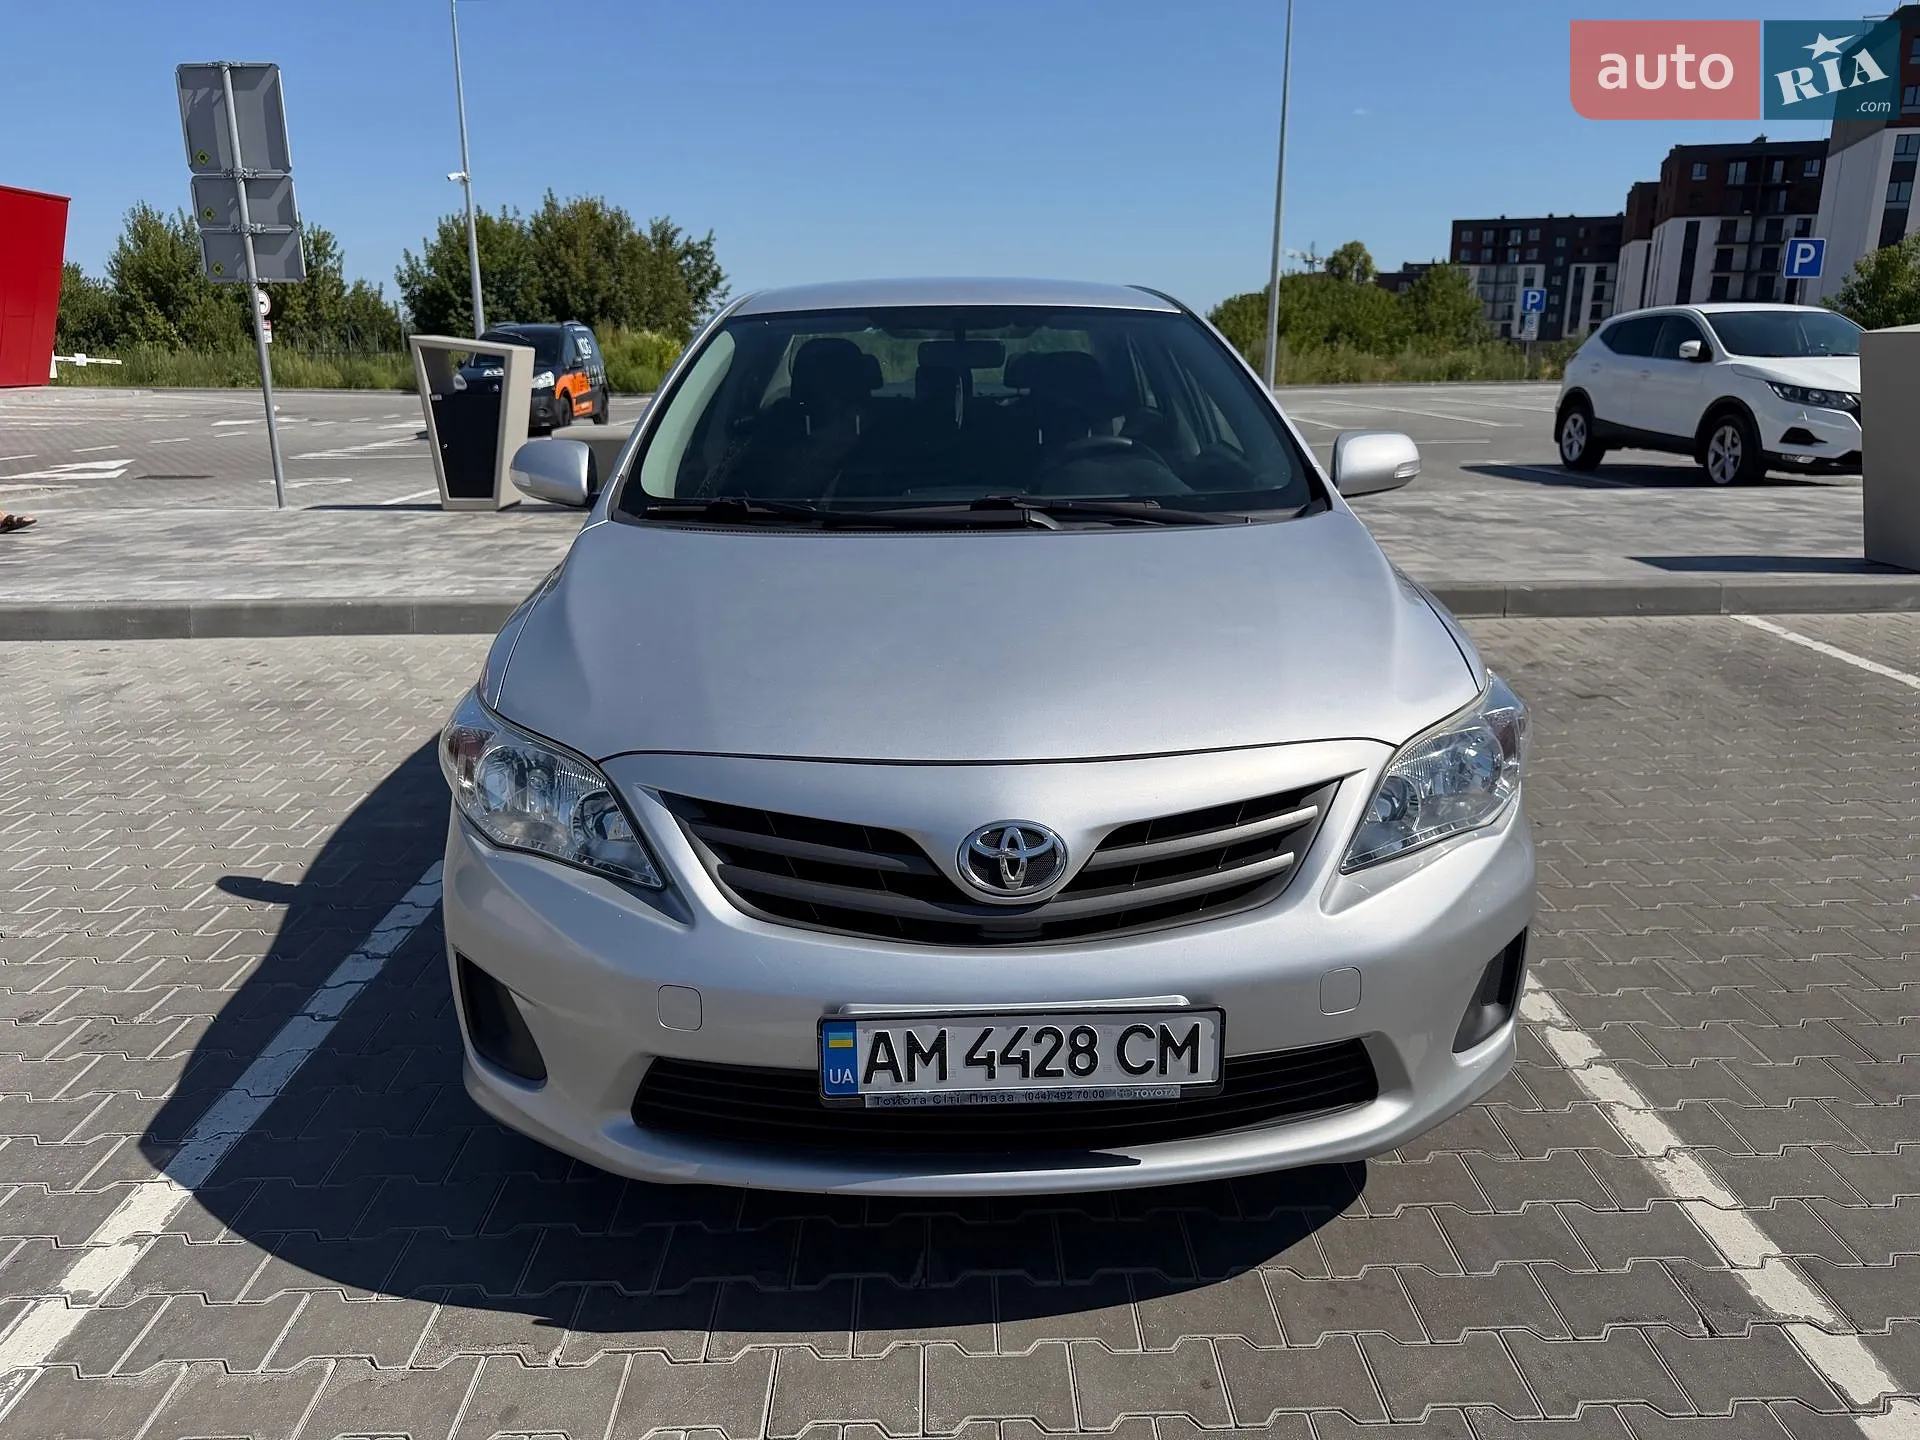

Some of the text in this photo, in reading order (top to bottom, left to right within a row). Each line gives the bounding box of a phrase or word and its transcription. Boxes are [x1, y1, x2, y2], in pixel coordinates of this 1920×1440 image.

[1793, 243, 1816, 274] P
[1526, 291, 1540, 310] P
[863, 1022, 1201, 1084] AM 4428 CM
[829, 1068, 855, 1084] UA
[968, 1093, 1014, 1104] Плаза
[1135, 1088, 1176, 1099] TOYOTA
